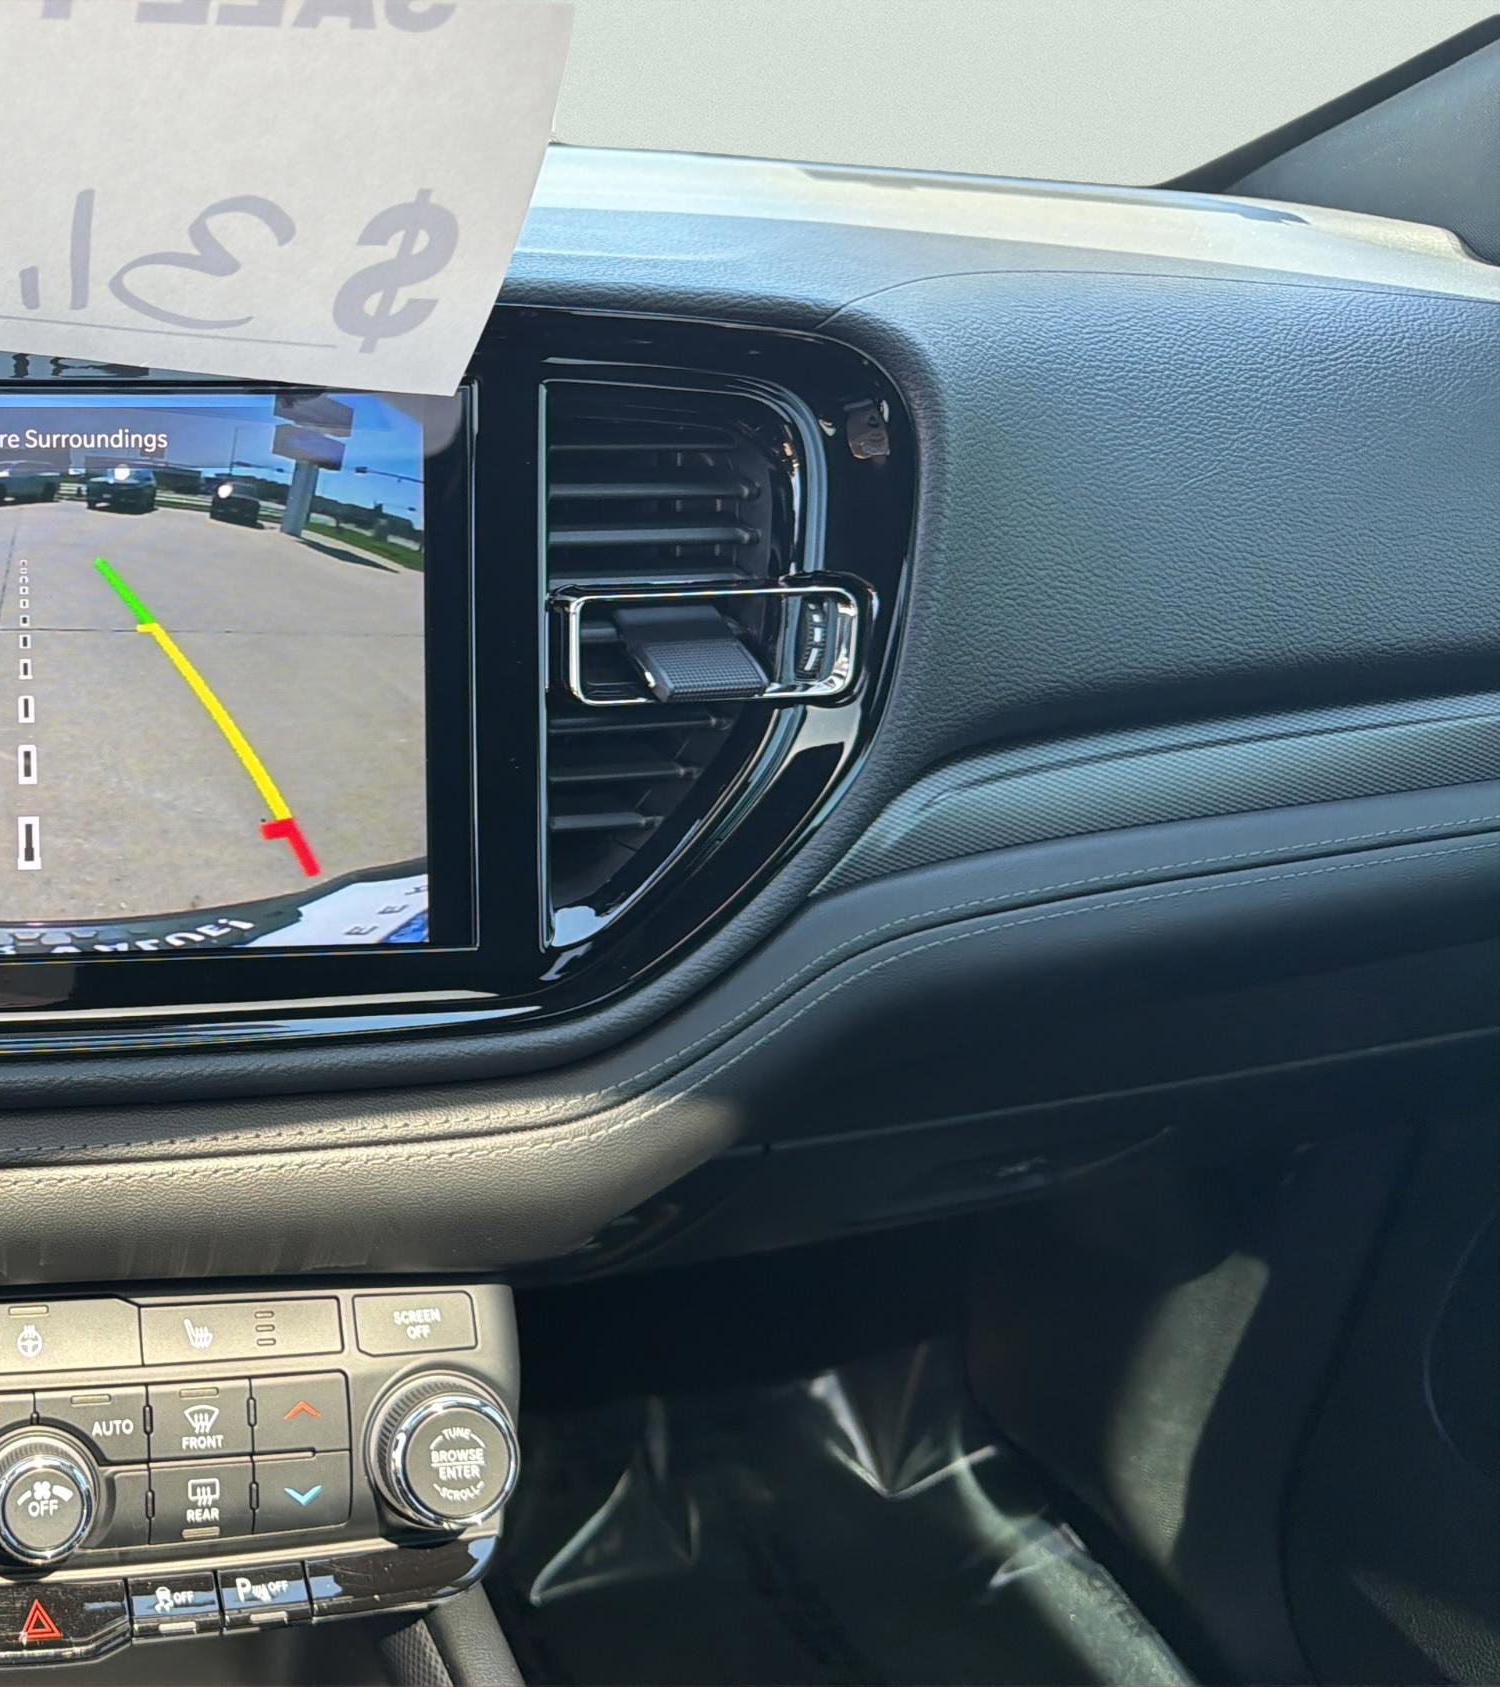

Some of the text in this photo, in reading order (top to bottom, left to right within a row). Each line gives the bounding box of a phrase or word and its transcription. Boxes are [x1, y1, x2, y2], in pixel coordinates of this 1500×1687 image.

[25, 428, 168, 451] Surroundings
[393, 1309, 440, 1325] SCREEN
[407, 1324, 430, 1339] OFF
[92, 1418, 134, 1437] AUTO
[441, 1427, 472, 1440] TUNE
[182, 1434, 224, 1450] FRONT
[431, 1448, 484, 1463] BROWSE
[439, 1465, 481, 1480] ENTER
[440, 1484, 480, 1501] SCROLL
[28, 1499, 59, 1516] OFF
[186, 1507, 220, 1523] REAR
[268, 1580, 289, 1593] OFF
[173, 1591, 195, 1604] OFF
